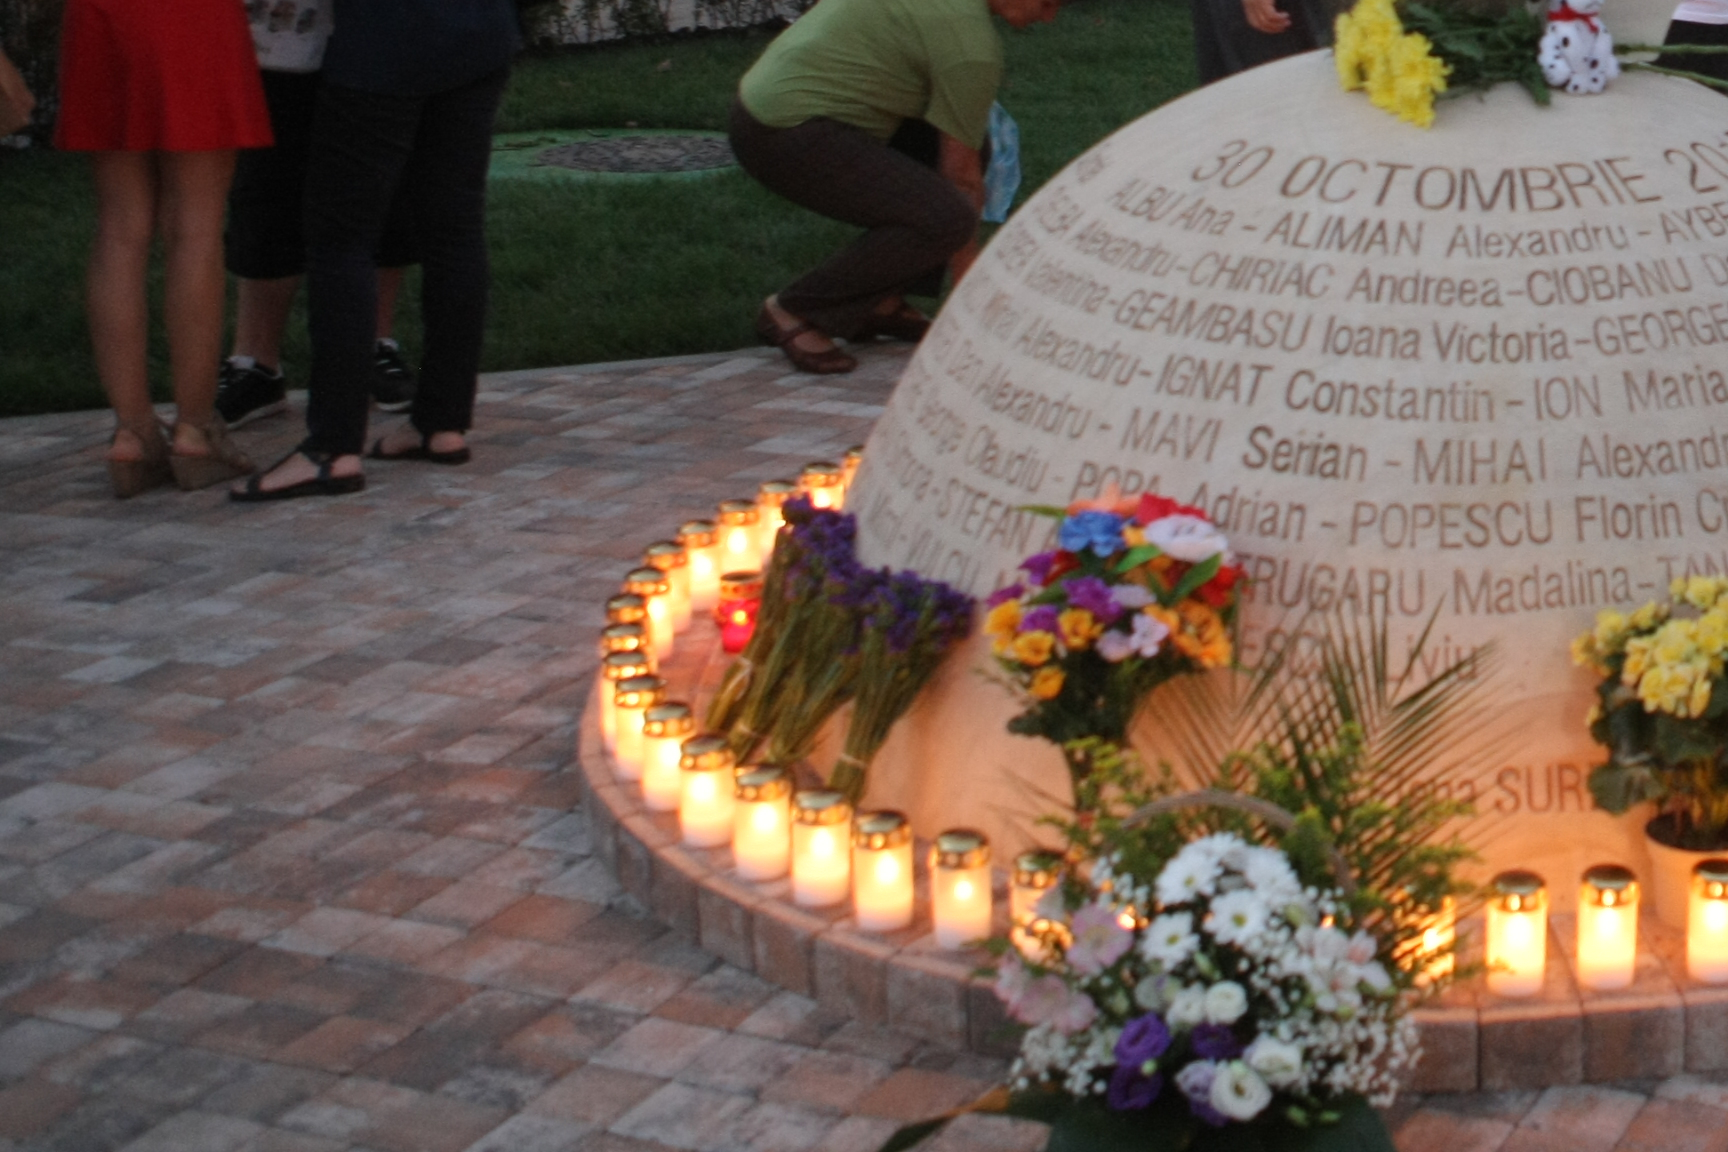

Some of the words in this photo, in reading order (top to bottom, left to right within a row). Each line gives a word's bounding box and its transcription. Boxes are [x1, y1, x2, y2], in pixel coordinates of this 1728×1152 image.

[1191, 138, 1275, 190] 30
[1279, 154, 1662, 213] OCTOMBRIE
[1168, 197, 1236, 237] Ana
[1264, 210, 1426, 257] ALIMAN
[1445, 221, 1630, 259] Alexandru
[1321, 315, 1421, 360] Ioana
[974, 362, 1093, 440] Alexandru
[1120, 405, 1223, 463] MAVI
[1241, 424, 1368, 484] Serian
[1412, 436, 1548, 486] MIHAI
[1284, 368, 1496, 423] Constantin
[1534, 374, 1604, 422] ION
[1348, 500, 1553, 550] POPESCU
[1574, 492, 1684, 543] Florin
